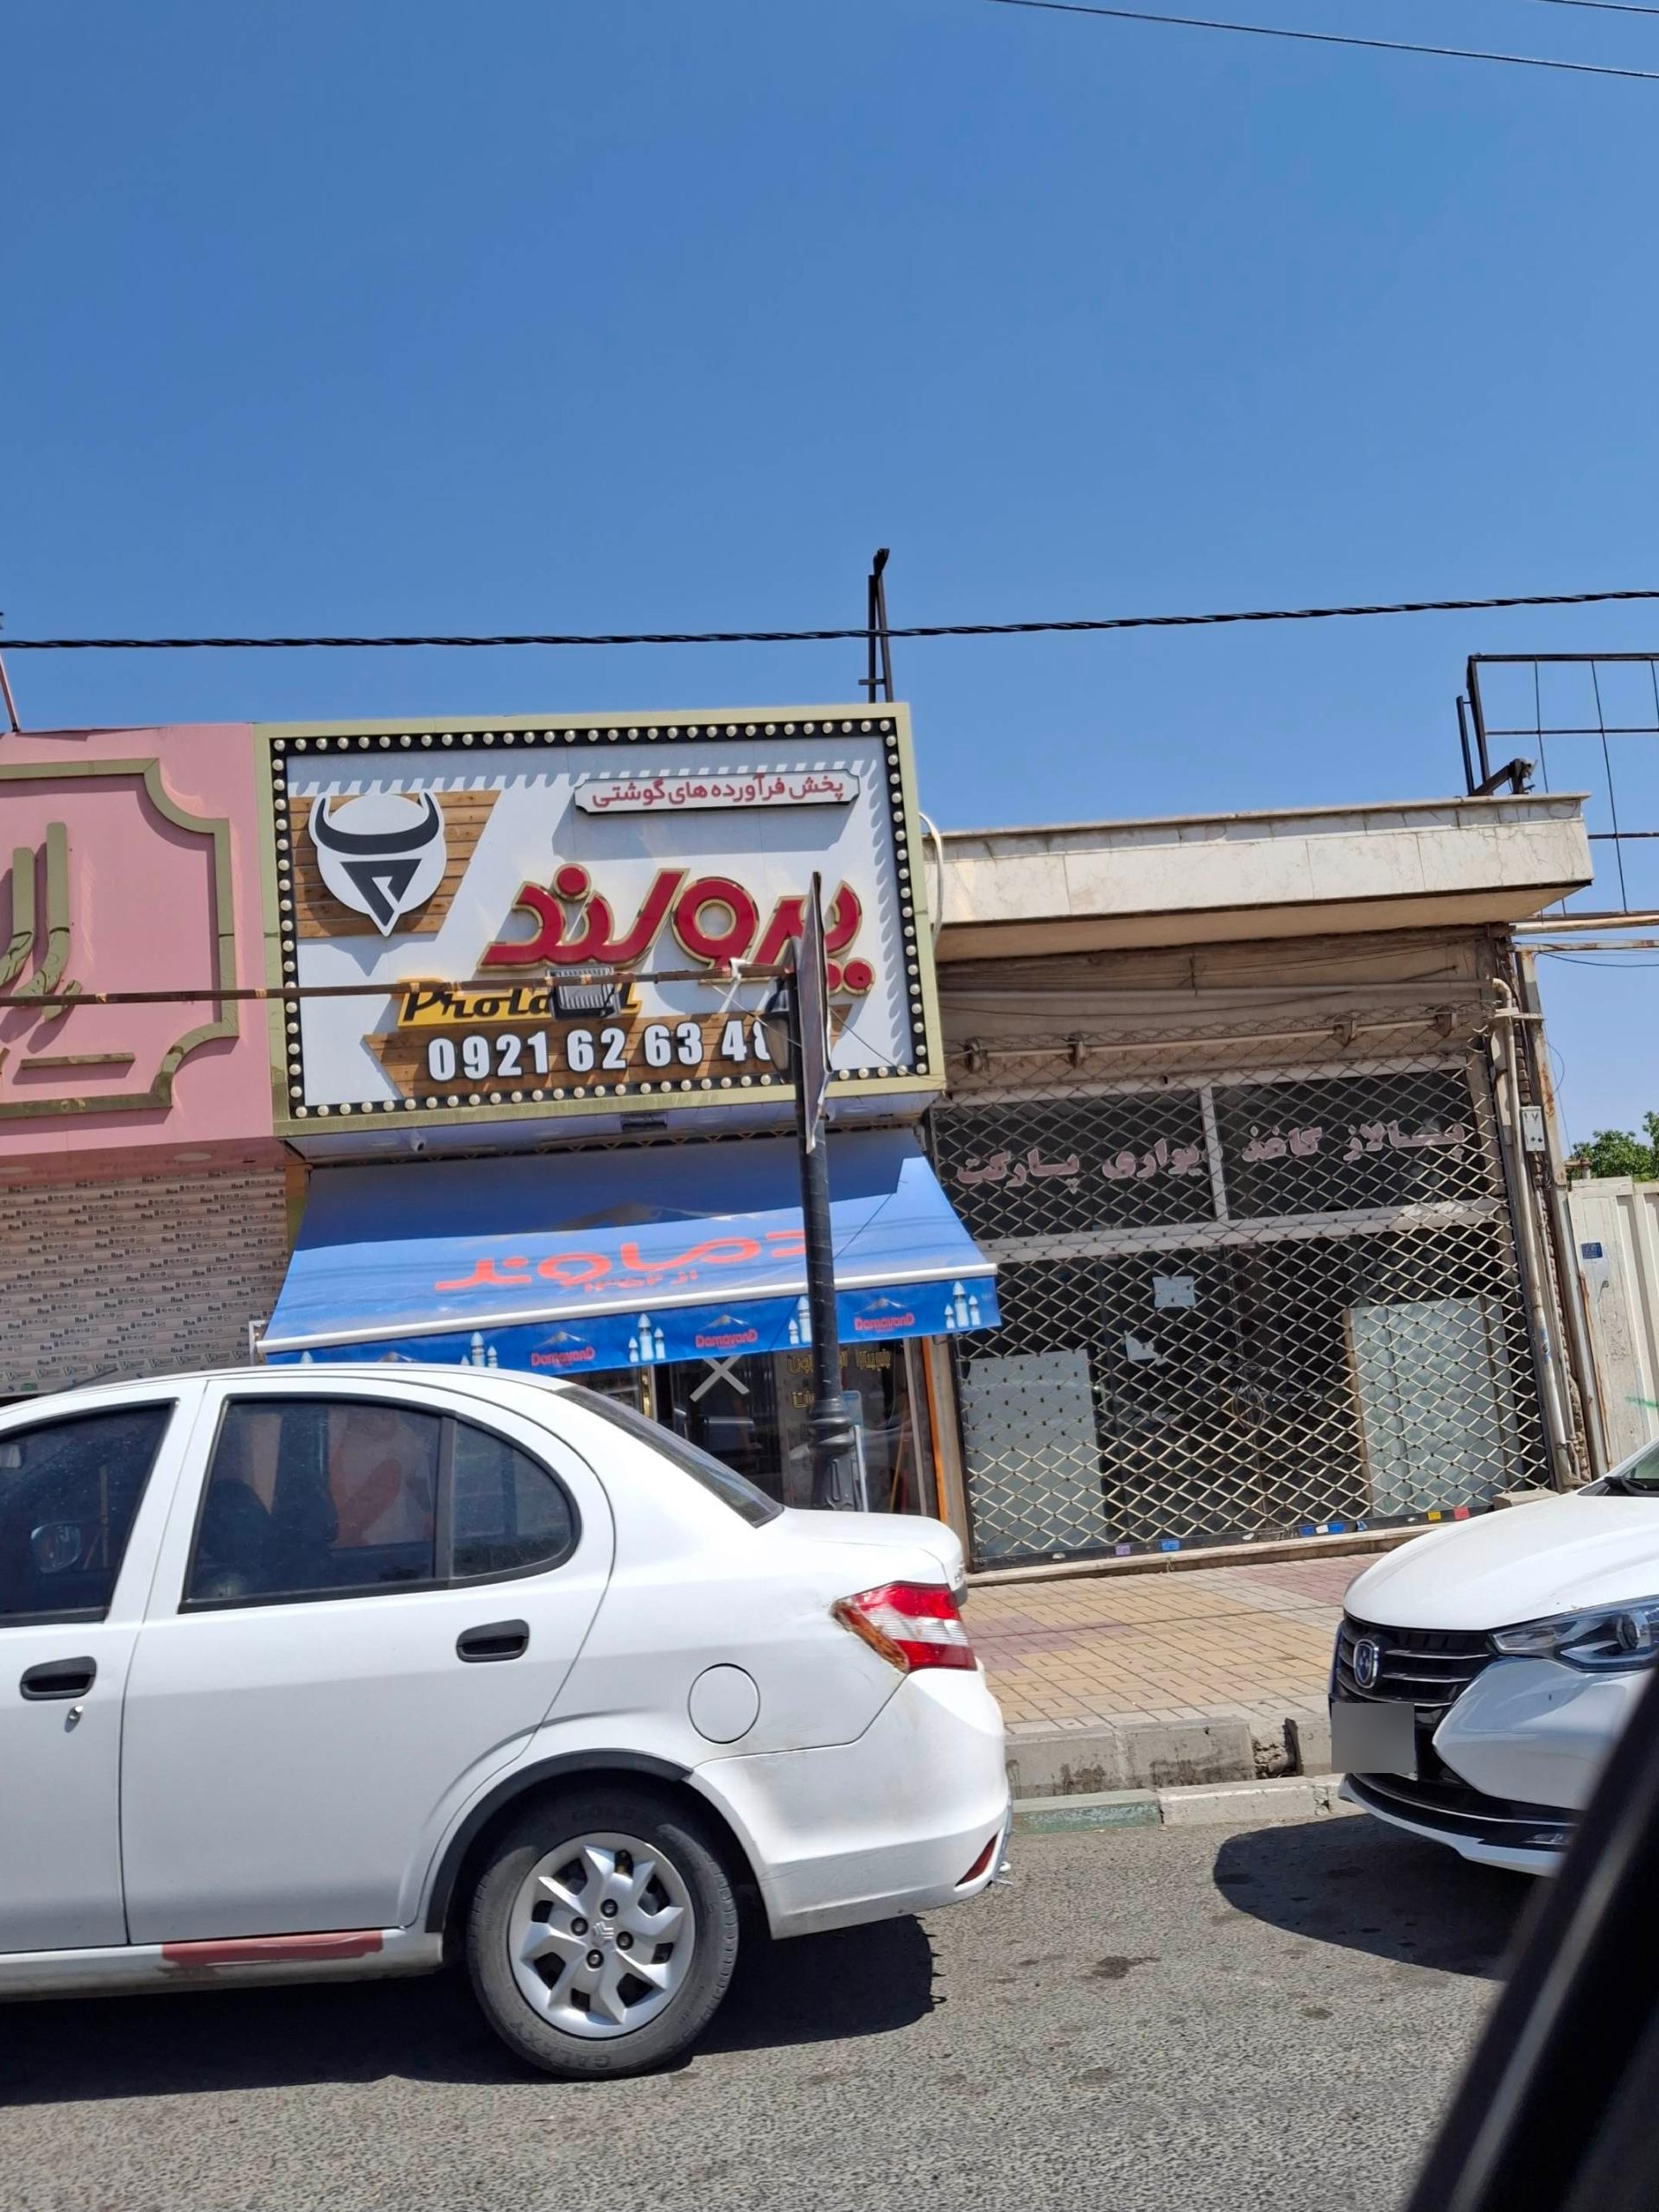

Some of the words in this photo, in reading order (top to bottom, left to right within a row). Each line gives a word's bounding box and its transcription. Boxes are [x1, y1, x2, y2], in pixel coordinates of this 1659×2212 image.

[592, 779, 664, 808] گوشتی
[668, 781, 708, 804] های
[711, 773, 785, 802] فرآورده
[789, 776, 844, 800] پخش
[403, 980, 638, 1021] Prola
[428, 1031, 550, 1082] 0921
[566, 1028, 627, 1072] 62
[644, 1023, 703, 1067] 63
[1242, 1124, 1323, 1162] کاغذ
[957, 1147, 1080, 1195] پارکت
